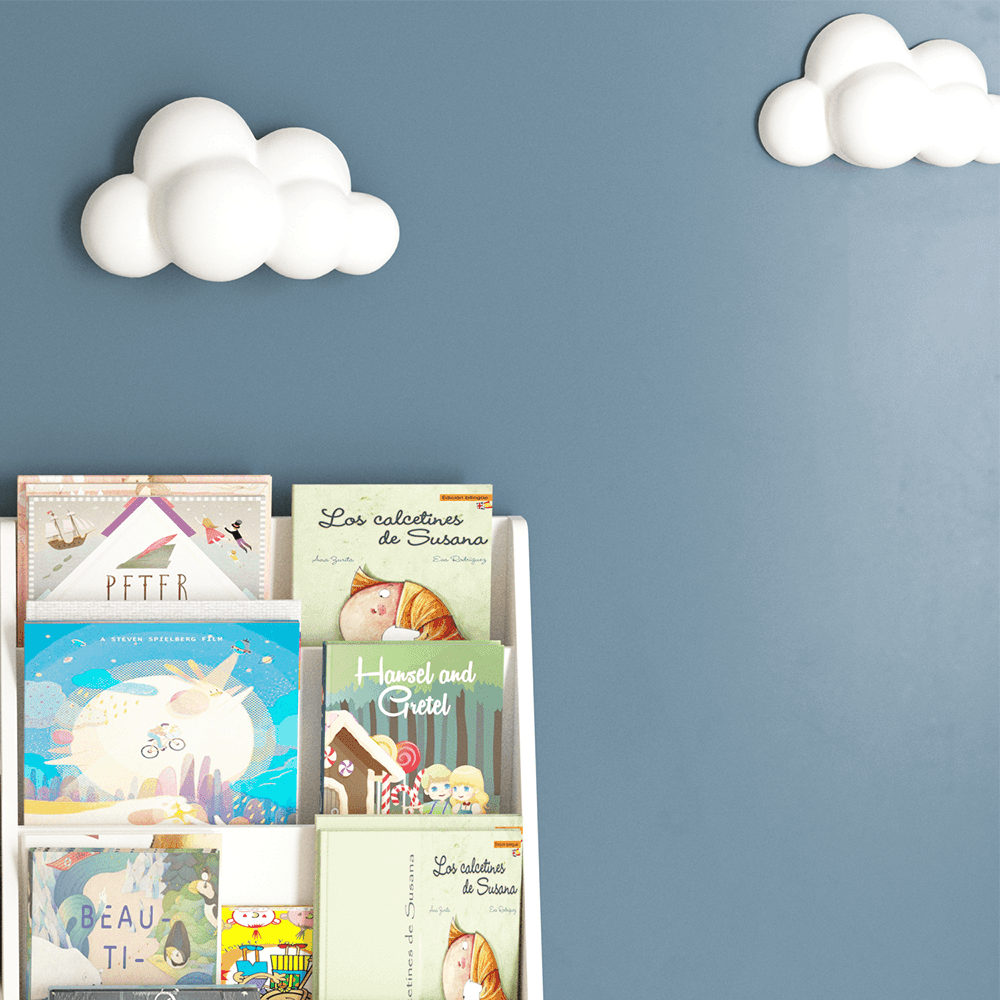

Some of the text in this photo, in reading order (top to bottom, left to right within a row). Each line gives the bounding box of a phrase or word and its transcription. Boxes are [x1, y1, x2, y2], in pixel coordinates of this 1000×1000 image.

[318, 508, 464, 528] Los calcetines
[379, 528, 488, 546] de Susana
[106, 574, 188, 600] PETER
[355, 656, 476, 685] Hansel and
[378, 685, 451, 719] Gretel
[433, 855, 506, 877] Los calcetines
[405, 854, 416, 919] Susana
[463, 877, 518, 895] de Susana
[81, 904, 170, 930] BEAU-
[405, 925, 413, 944] de
[103, 945, 144, 970] TI-
